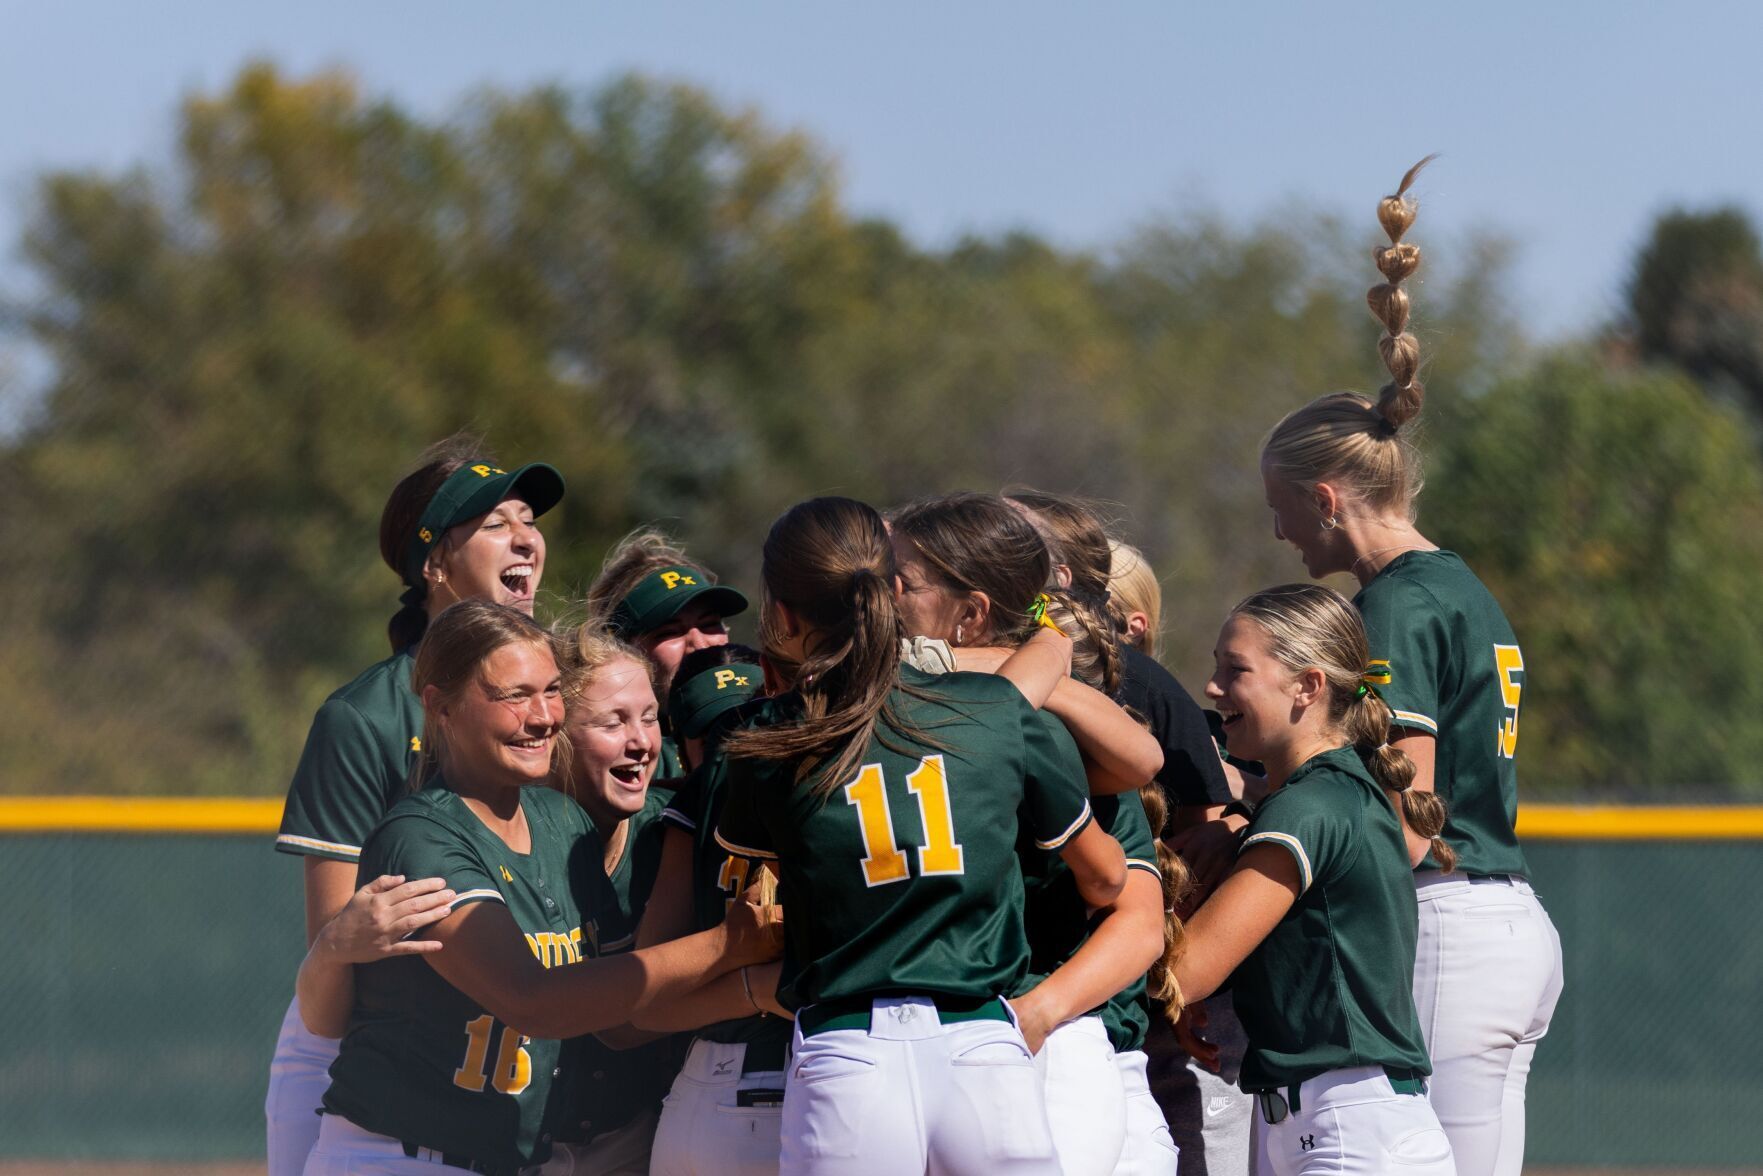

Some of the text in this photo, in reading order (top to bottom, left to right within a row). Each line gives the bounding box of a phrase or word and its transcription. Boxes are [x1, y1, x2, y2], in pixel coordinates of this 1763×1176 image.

[1493, 643, 1525, 760] 5
[844, 753, 965, 888] 11
[453, 1014, 532, 1095] 16
[1209, 1095, 1231, 1109] NIKE
